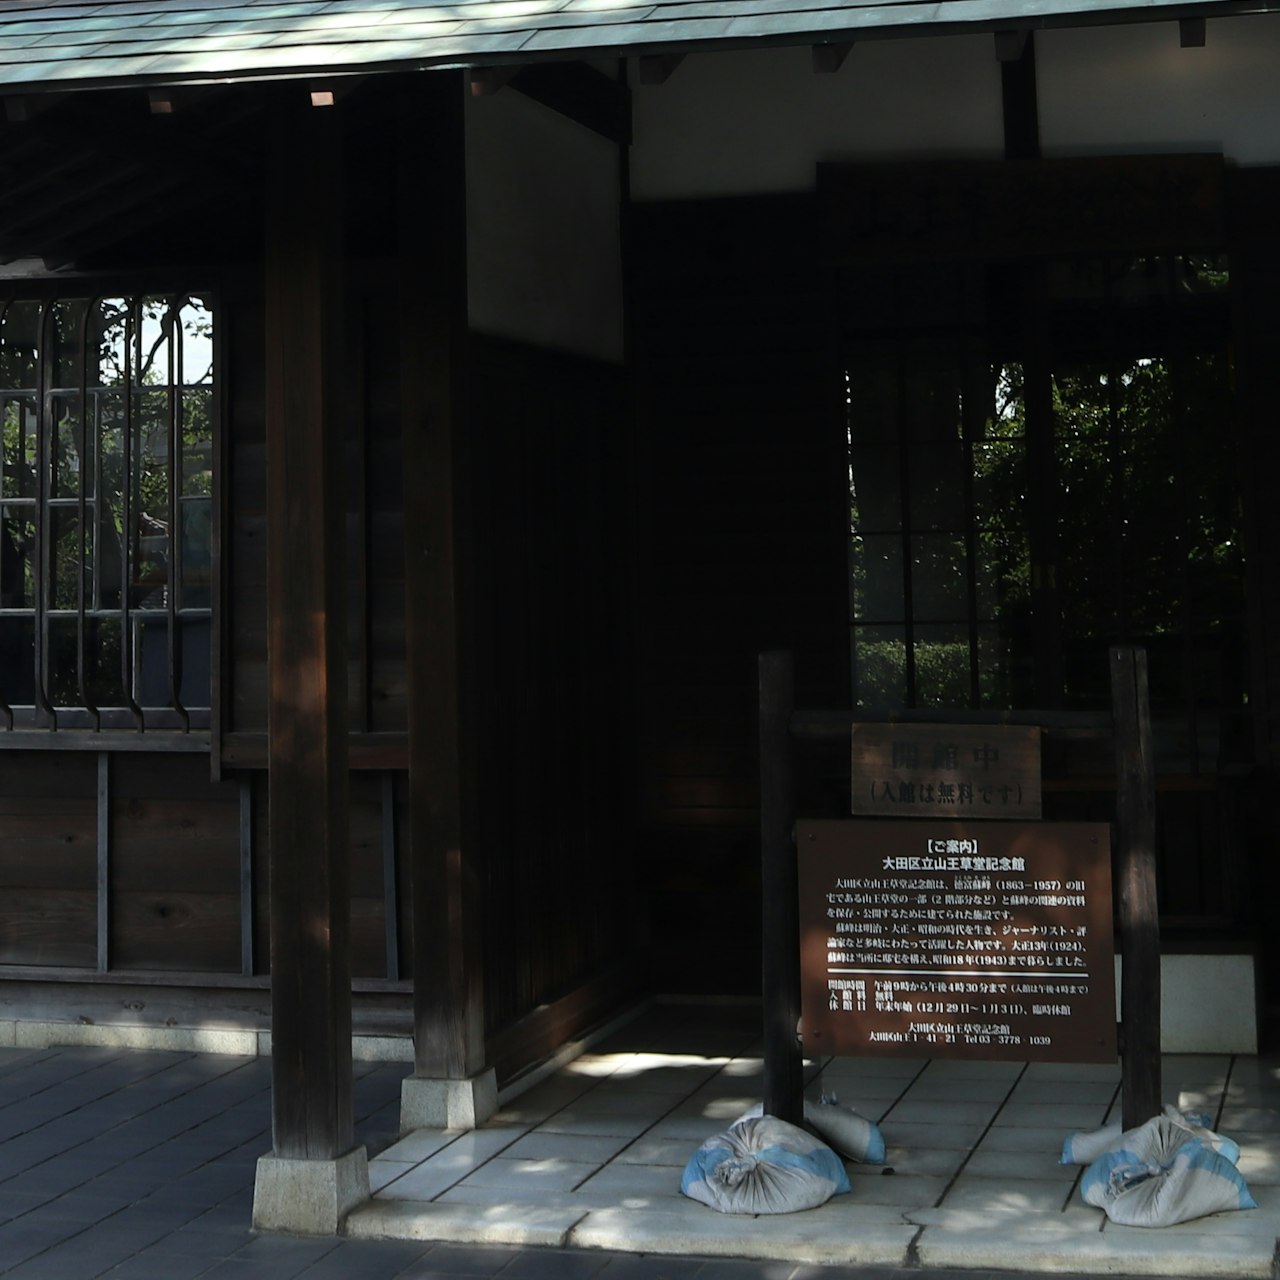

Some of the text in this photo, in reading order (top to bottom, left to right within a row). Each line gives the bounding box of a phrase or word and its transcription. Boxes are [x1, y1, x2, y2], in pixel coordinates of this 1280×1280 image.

[882, 856, 1025, 871] 大田区立山王草堂記念館
